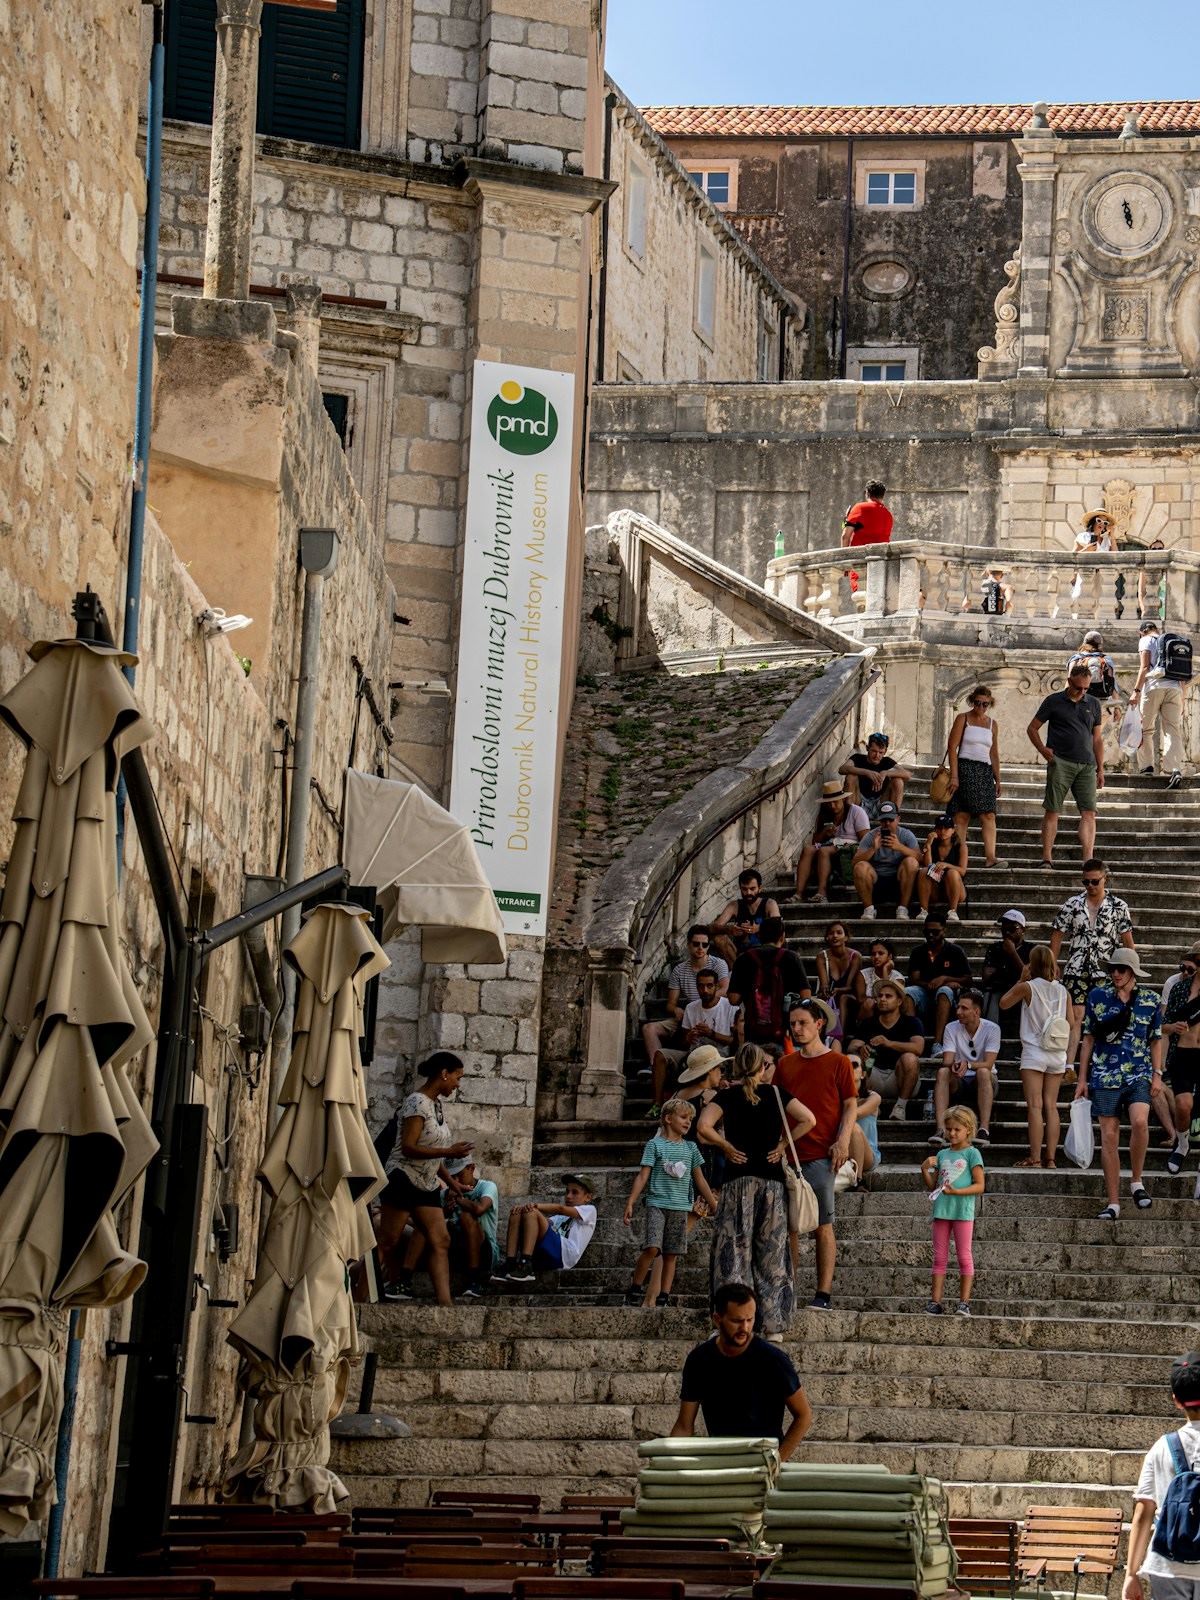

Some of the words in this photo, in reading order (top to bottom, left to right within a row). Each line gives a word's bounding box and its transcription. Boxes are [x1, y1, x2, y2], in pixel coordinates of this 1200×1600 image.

[496, 396, 549, 444] pmd
[483, 469, 515, 601] Dubrovnik
[524, 473, 549, 564] Museum
[485, 605, 517, 679] muzej
[519, 570, 548, 642] History
[515, 651, 539, 732] Natural
[471, 684, 502, 849] Prirodoslovni
[507, 741, 536, 852] Dubrovnik
